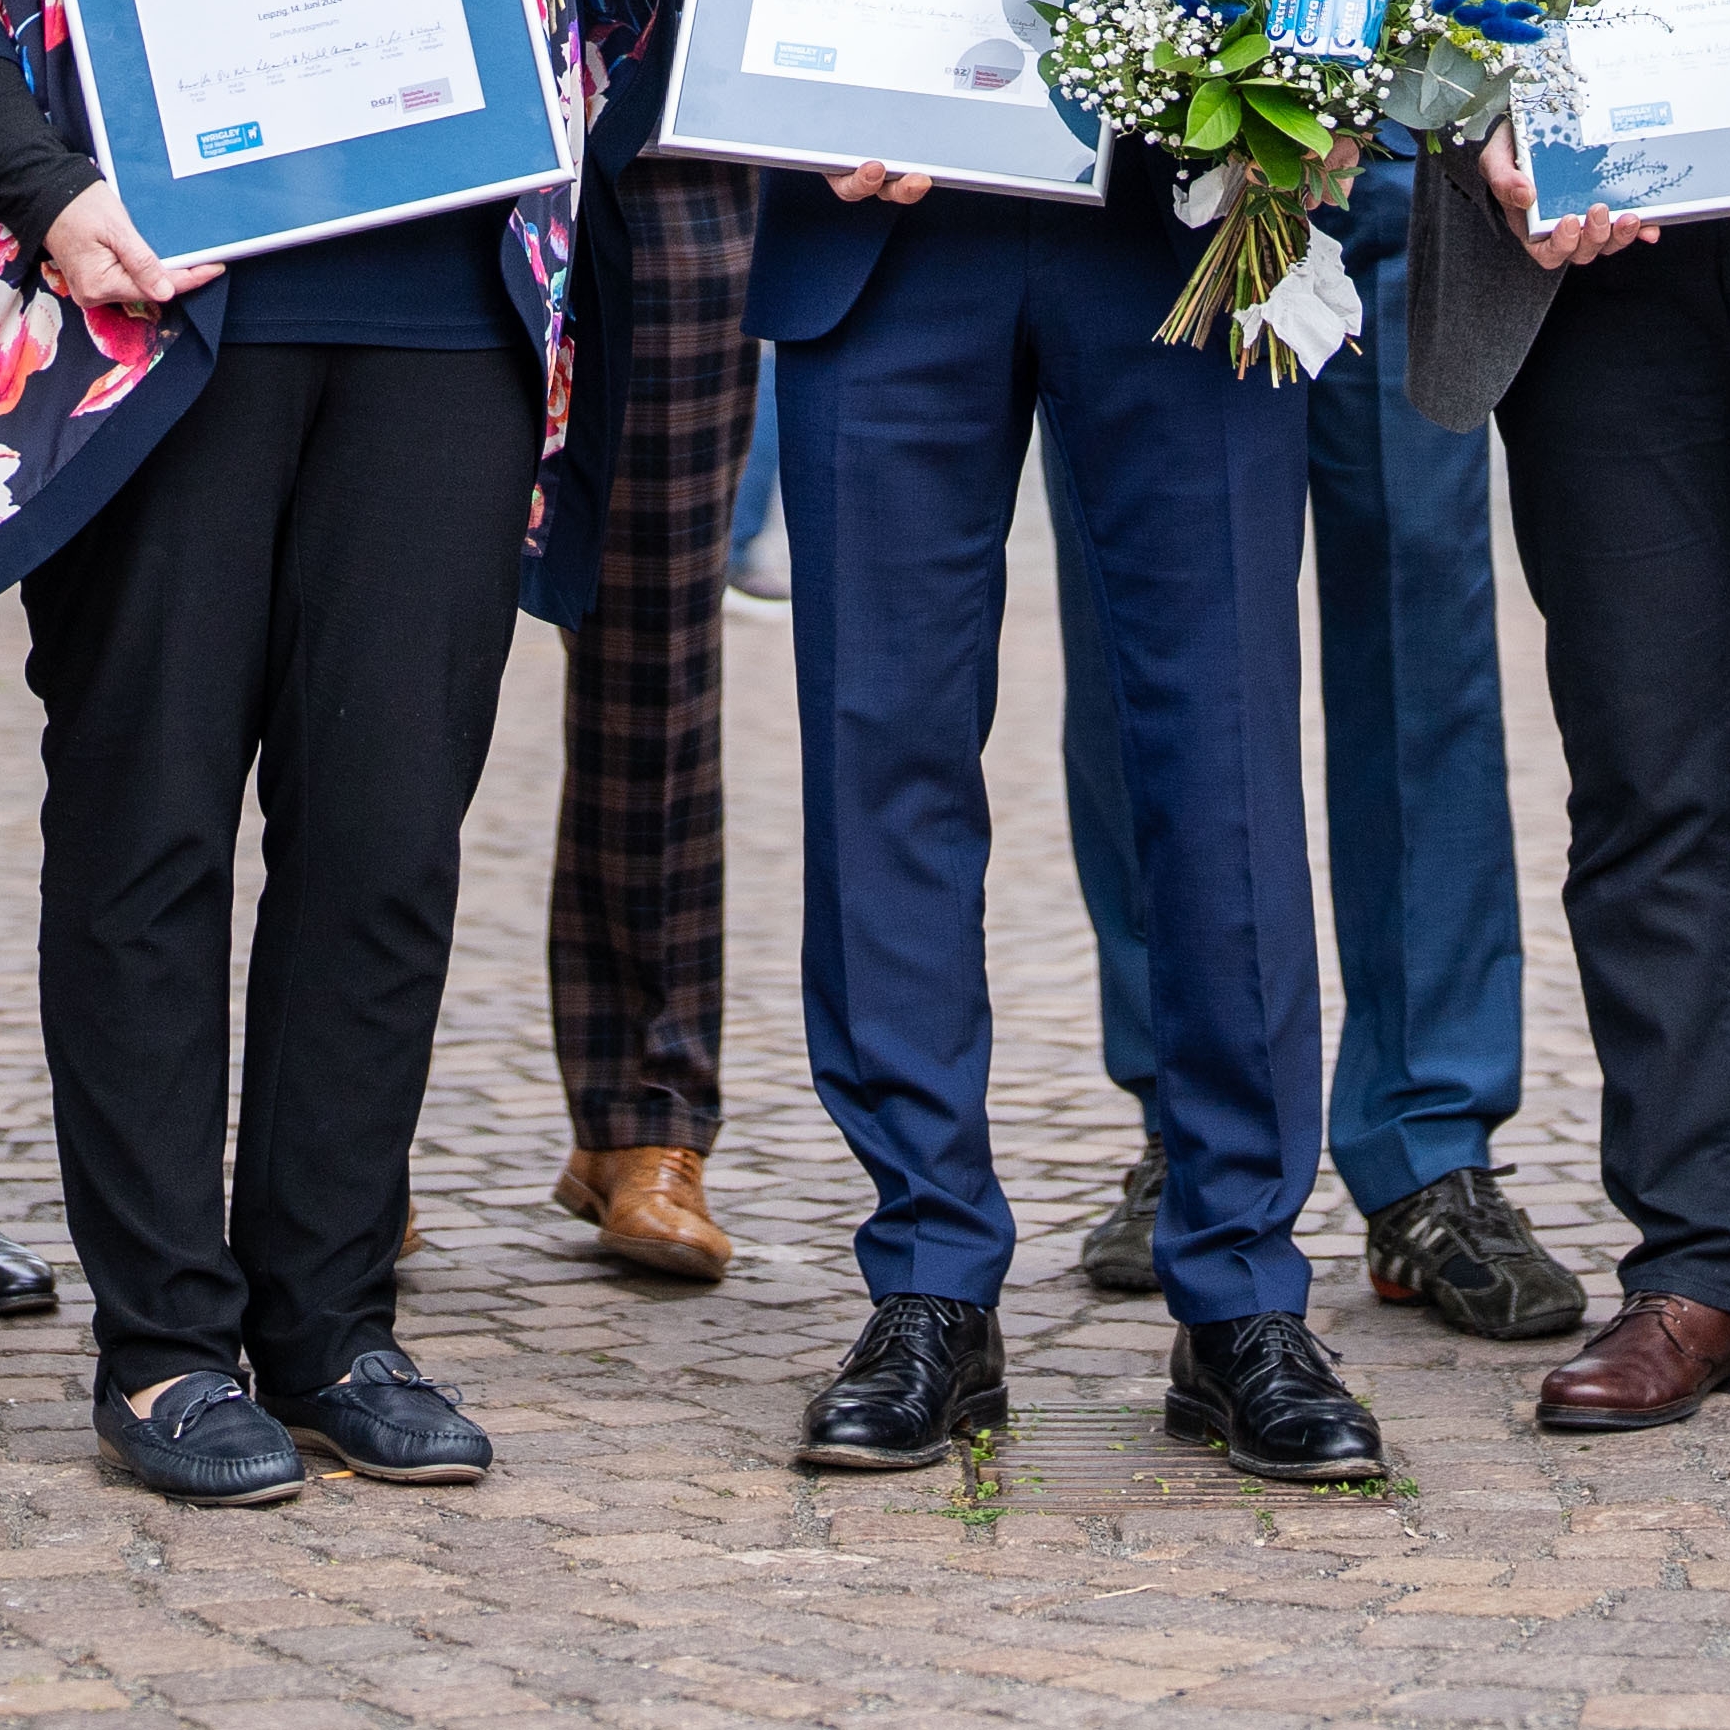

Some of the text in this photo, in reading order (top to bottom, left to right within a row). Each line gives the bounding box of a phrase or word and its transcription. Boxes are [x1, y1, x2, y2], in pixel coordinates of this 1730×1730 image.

[289, 3, 300, 13] 14.
[302, 0, 321, 11] Juni
[1299, 0, 1320, 44] extra
[199, 126, 242, 144] WRIGLEY
